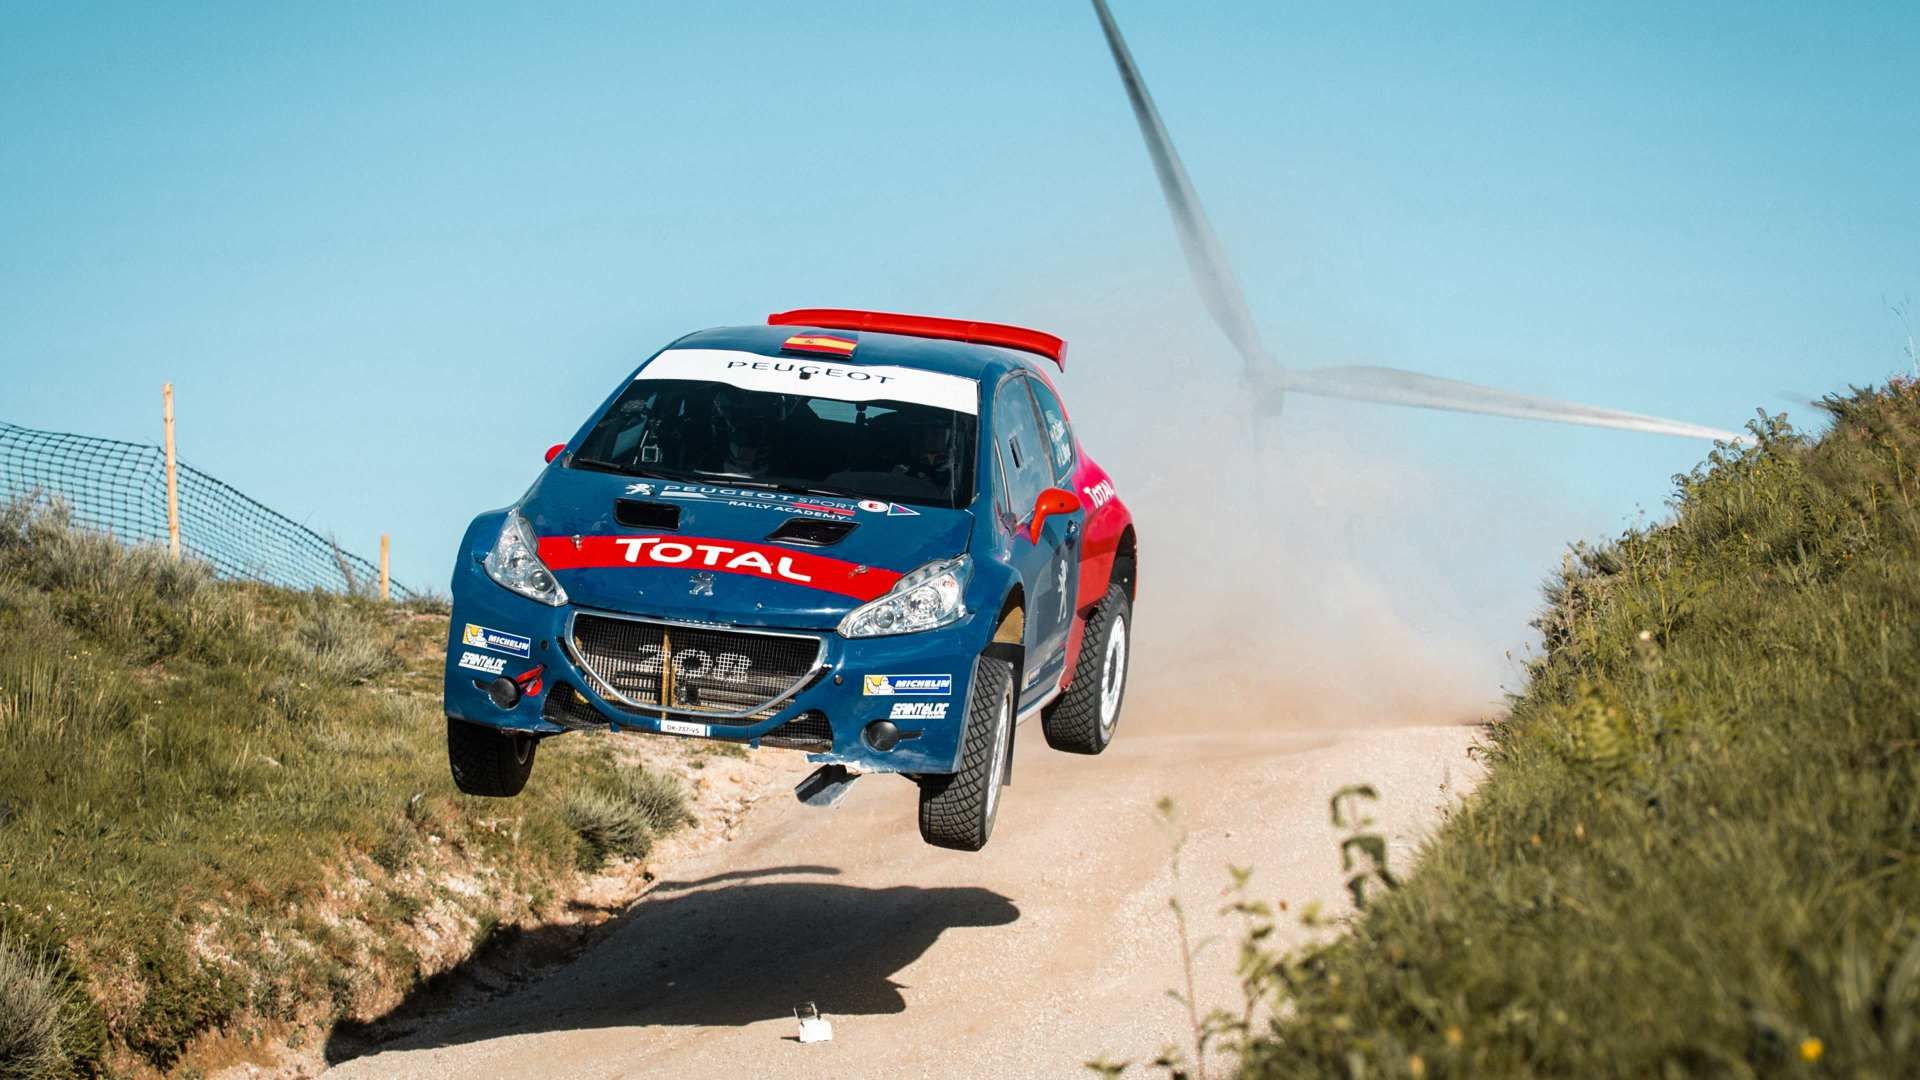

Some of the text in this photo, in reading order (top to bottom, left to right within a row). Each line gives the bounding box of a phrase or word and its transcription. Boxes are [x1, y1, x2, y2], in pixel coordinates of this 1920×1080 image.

[727, 361, 896, 384] PEUGEOT
[663, 485, 858, 511] PEUGEOT SPORT
[728, 500, 848, 520] RALLY ACADEMY
[616, 537, 812, 583] TOTAL
[488, 634, 530, 651] MICHELIN
[895, 679, 950, 689] MICHELIN
